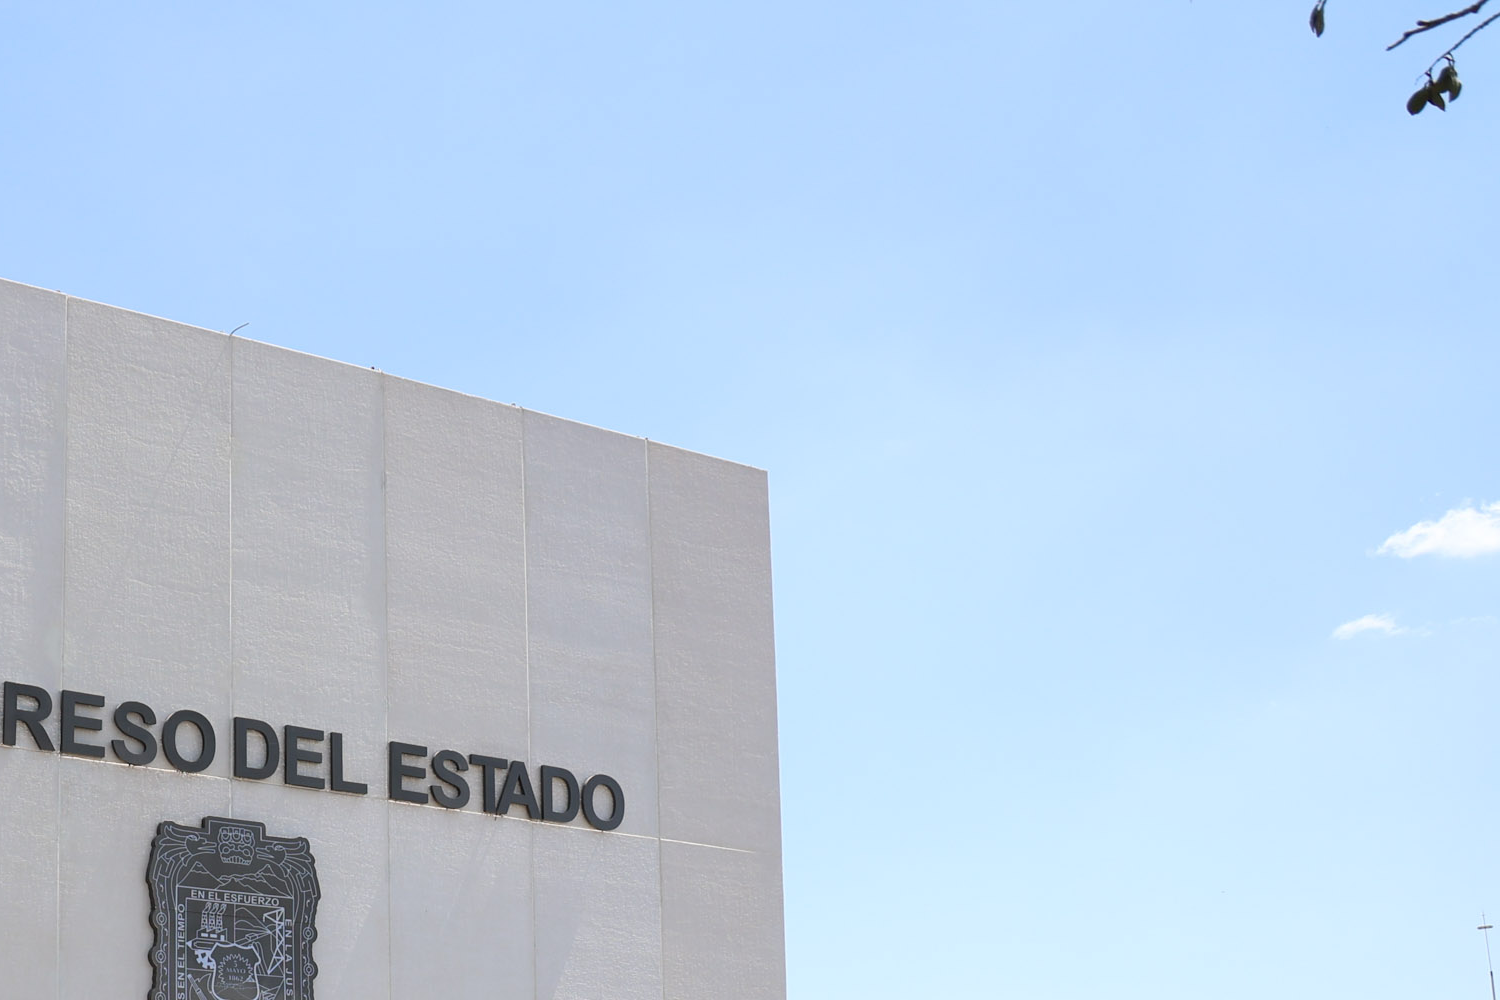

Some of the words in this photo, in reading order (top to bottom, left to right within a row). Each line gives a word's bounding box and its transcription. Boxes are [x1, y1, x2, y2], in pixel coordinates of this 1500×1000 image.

[233, 716, 368, 795] DEL
[389, 741, 626, 831] ESTADO
[191, 890, 205, 900] EN
[208, 892, 221, 901] EL
[224, 893, 280, 906] ESFUERZO
[285, 919, 292, 938] EN
[178, 953, 185, 968] EL
[285, 944, 292, 962] LA
[178, 972, 185, 989] EN
